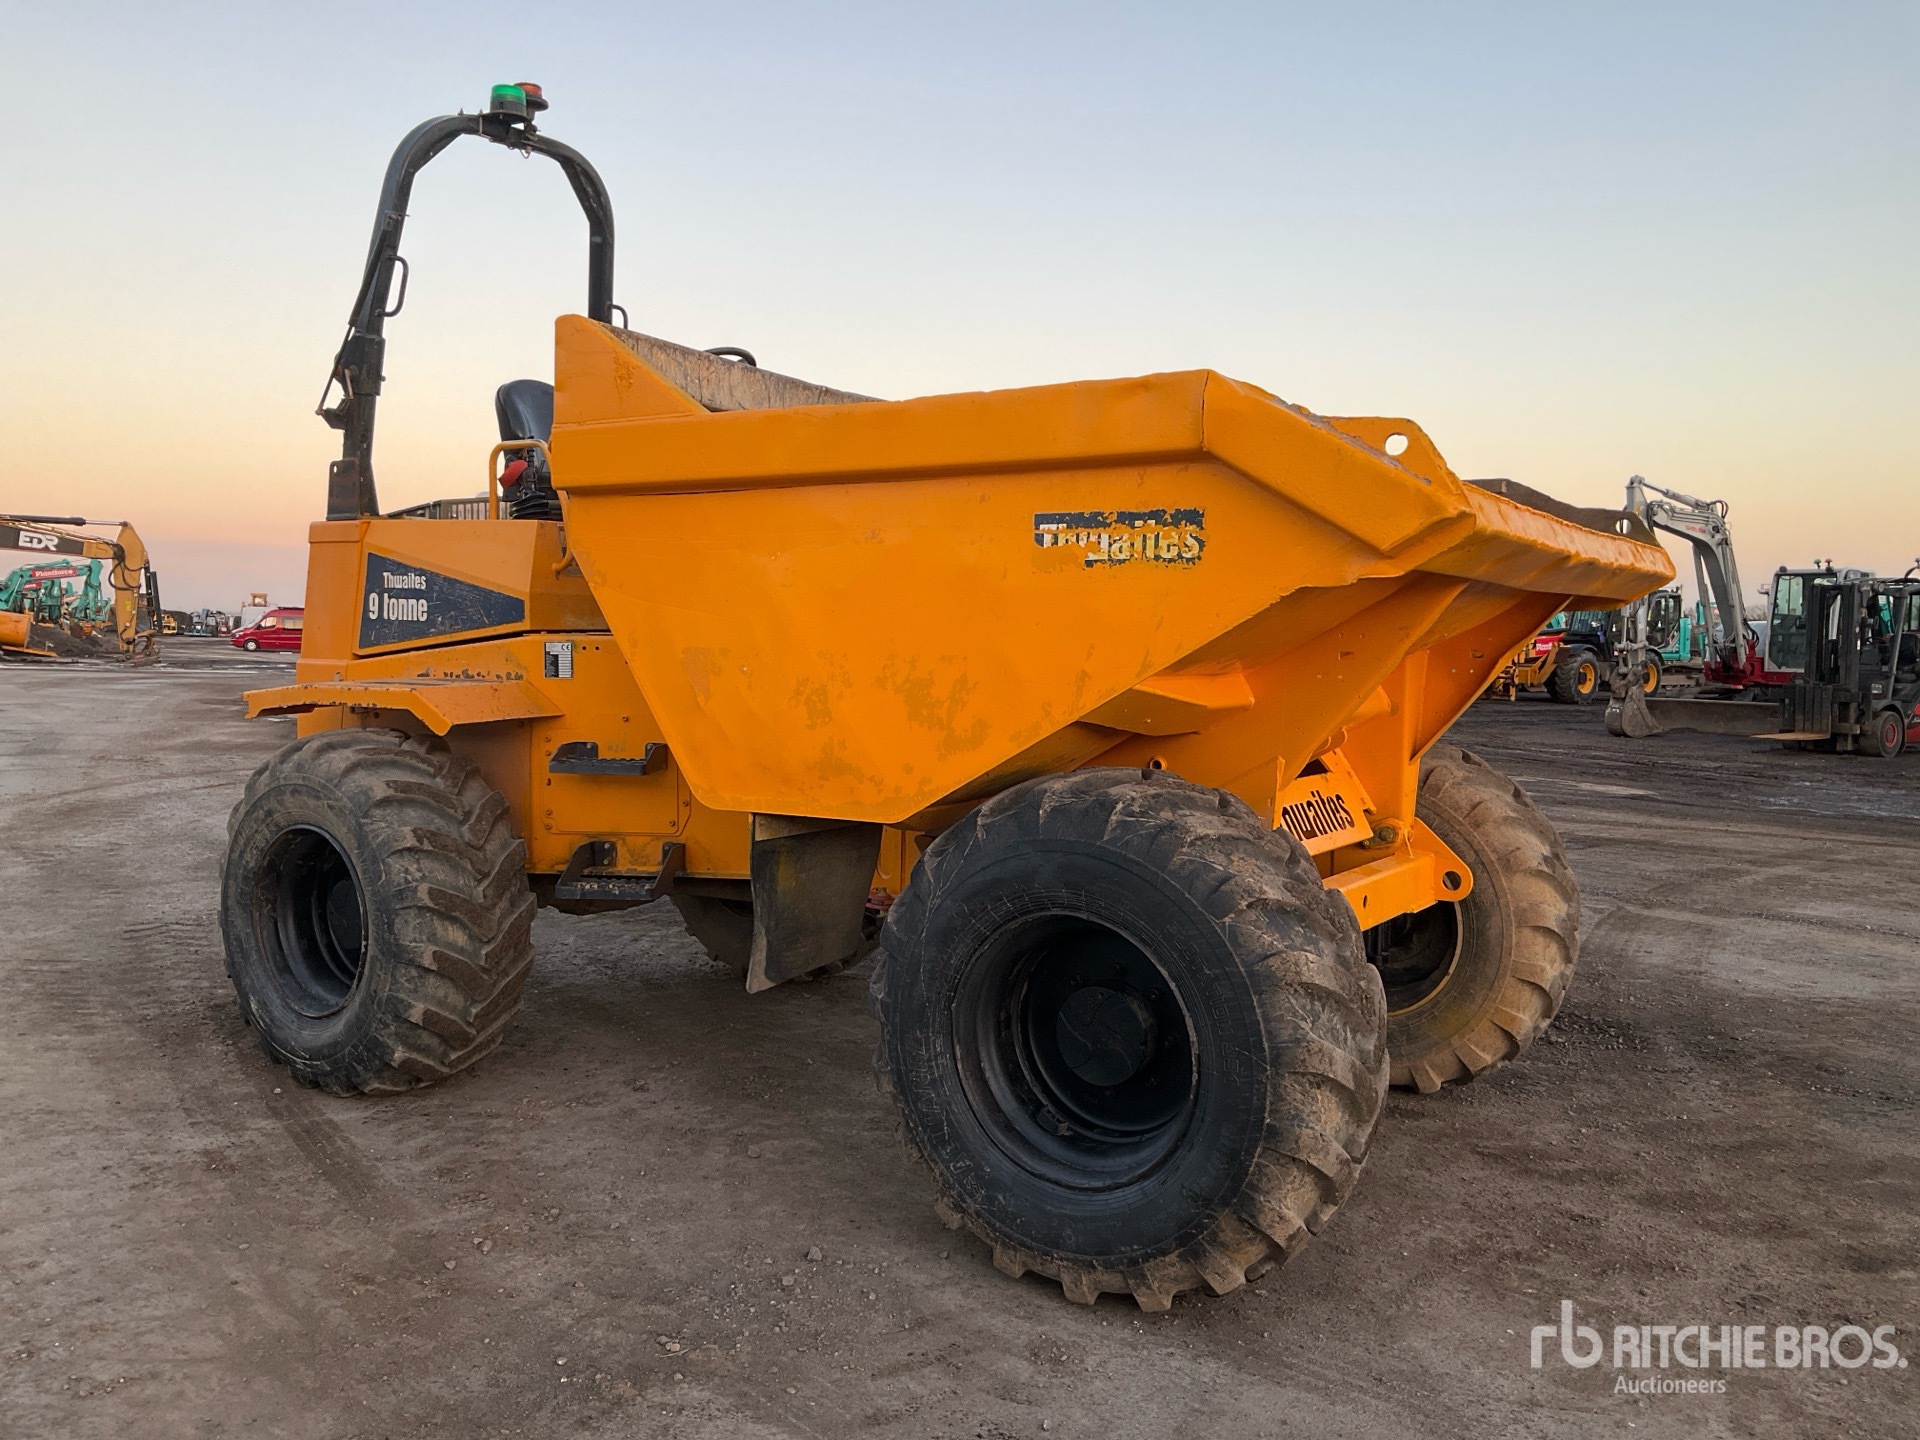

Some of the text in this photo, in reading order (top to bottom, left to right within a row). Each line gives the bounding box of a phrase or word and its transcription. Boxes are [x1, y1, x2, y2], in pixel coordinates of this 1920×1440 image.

[18, 530, 59, 551] EDR
[383, 571, 427, 590] Thwaites
[369, 592, 428, 622] 9 tonne
